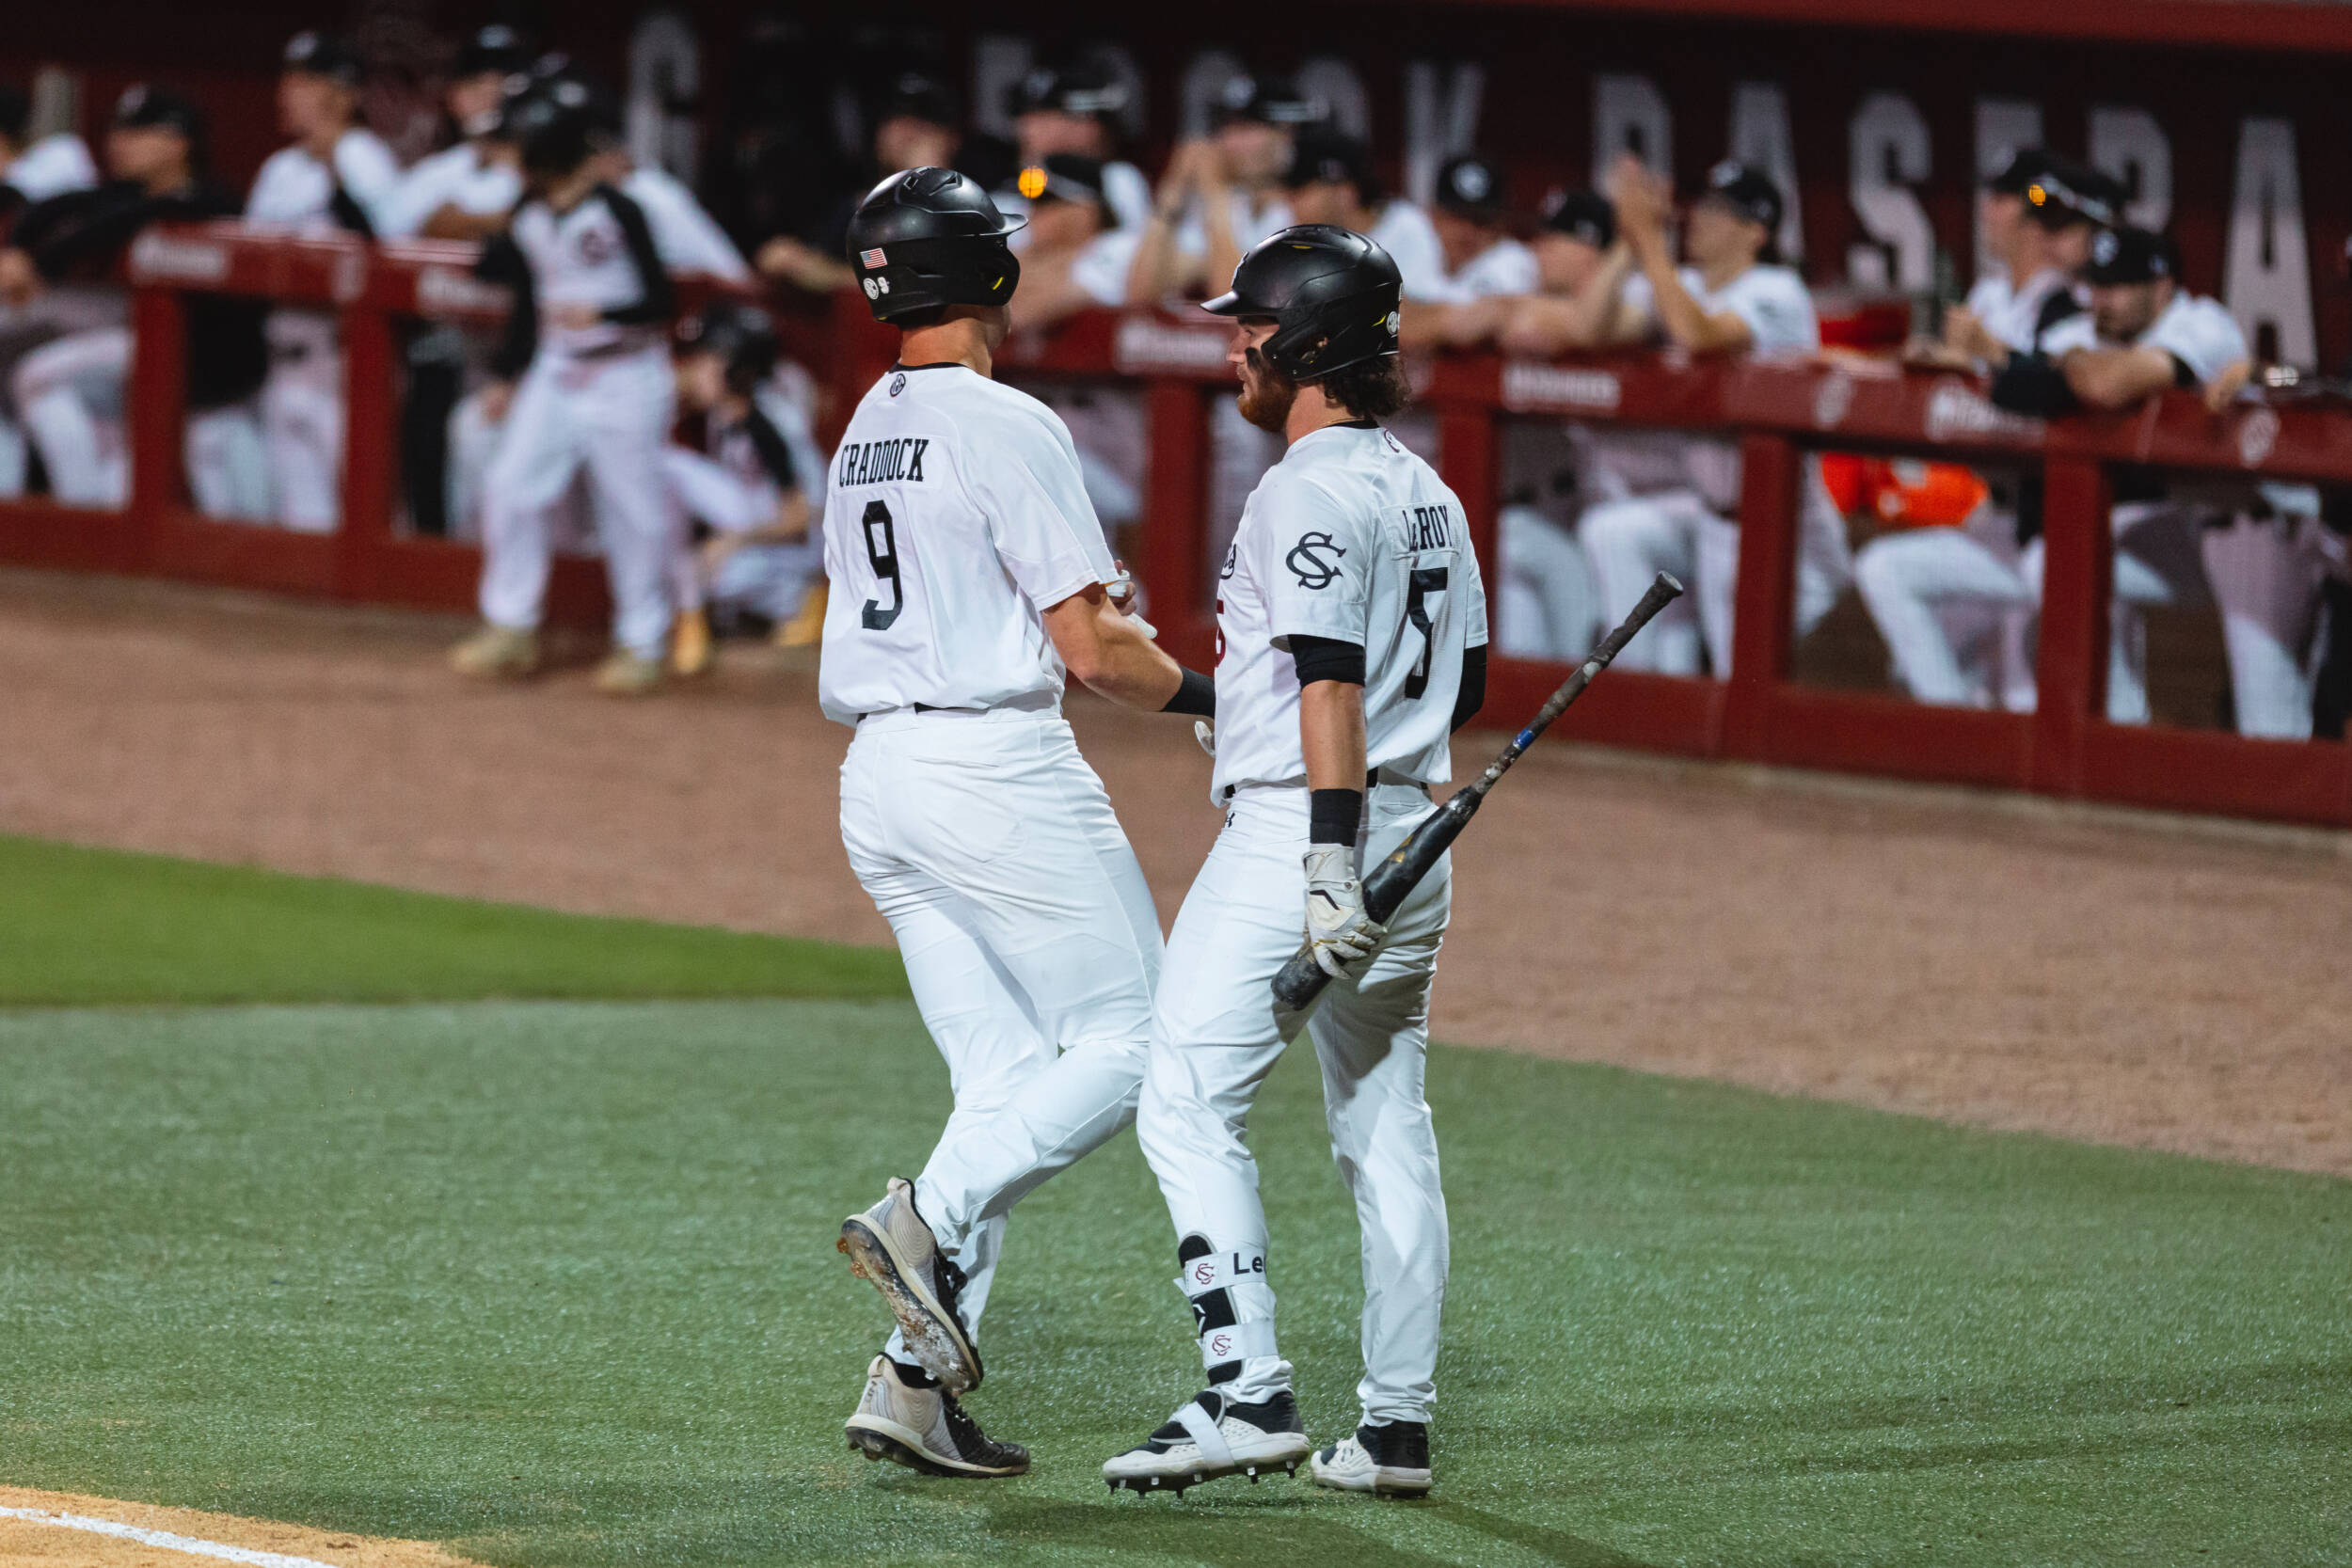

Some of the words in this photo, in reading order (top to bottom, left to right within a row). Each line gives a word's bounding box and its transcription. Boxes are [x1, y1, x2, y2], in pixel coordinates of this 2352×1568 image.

[839, 438, 930, 488] CRADDOCK
[862, 499, 903, 631] 9
[1405, 566, 1449, 700] 5
[1233, 1252, 1267, 1275] Le
